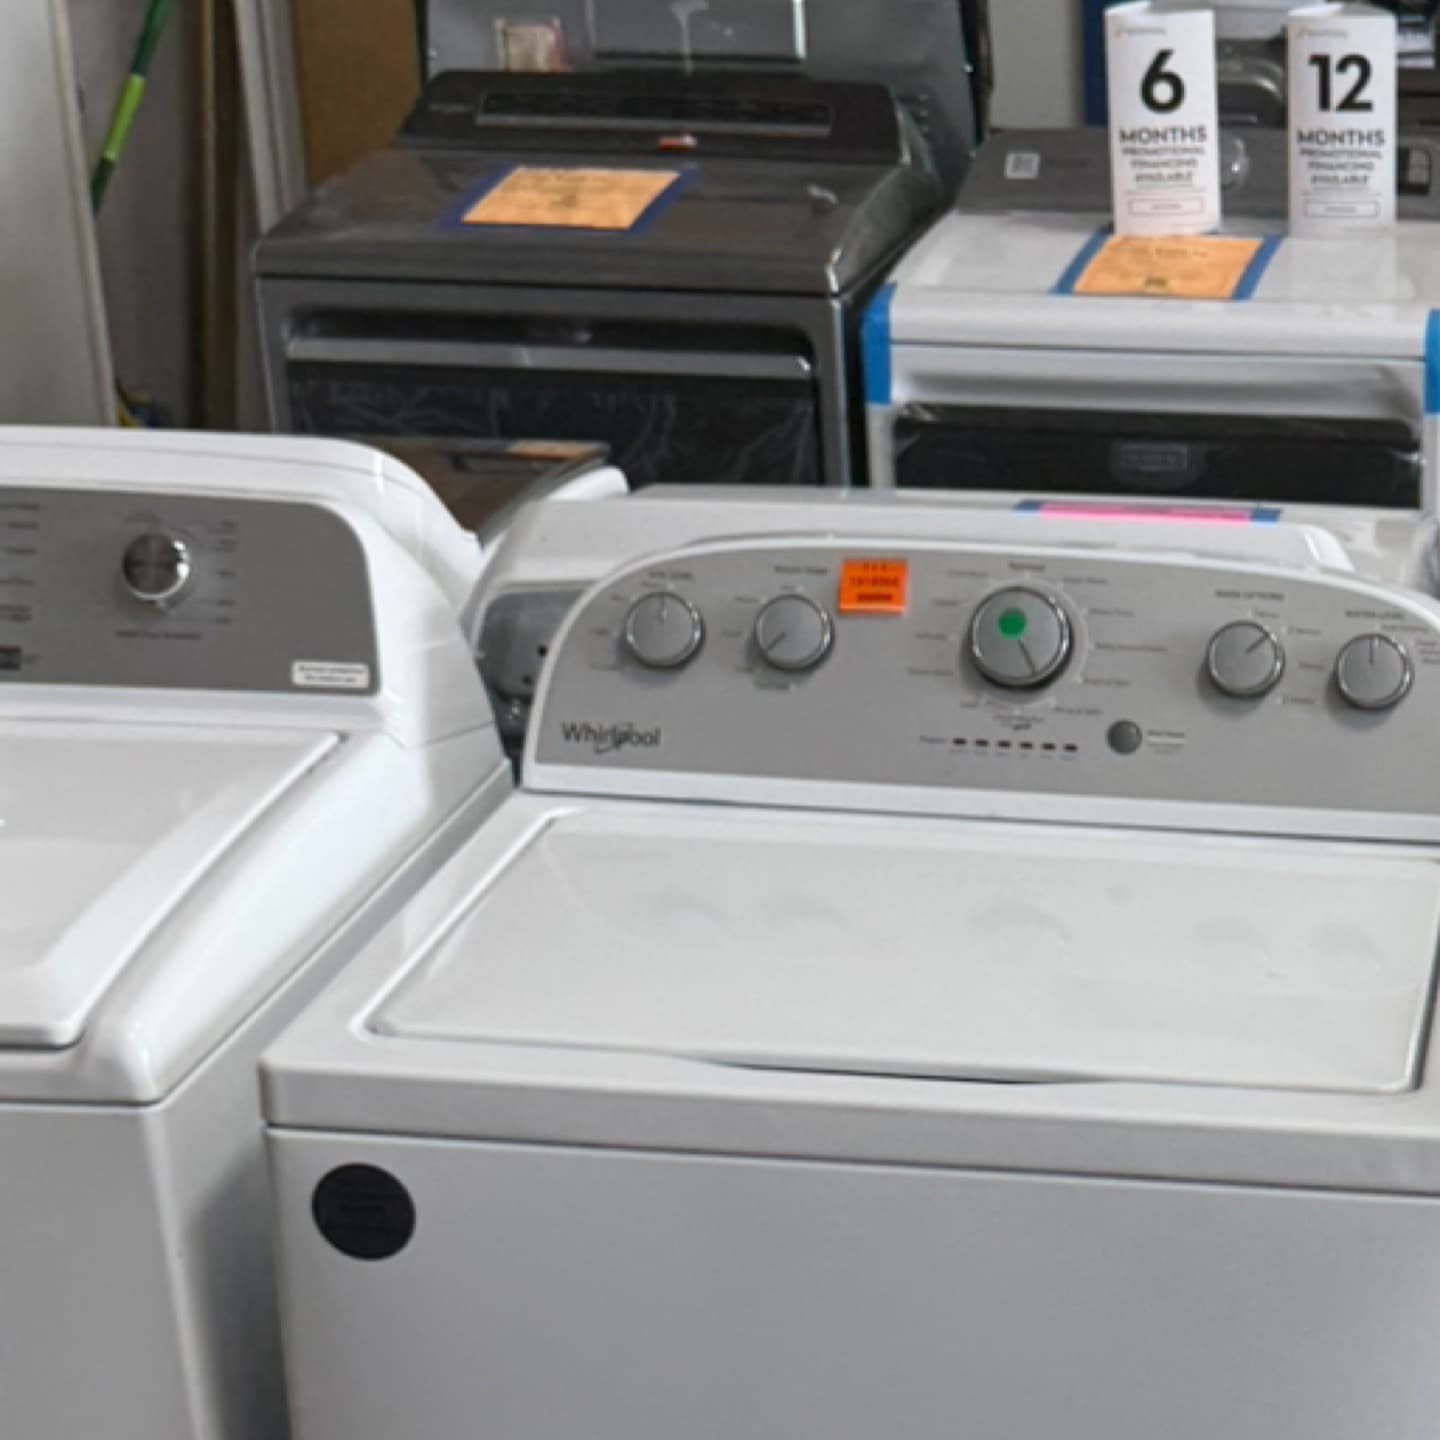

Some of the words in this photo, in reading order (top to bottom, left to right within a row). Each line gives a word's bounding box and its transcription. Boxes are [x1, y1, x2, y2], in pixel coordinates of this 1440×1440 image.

[1140, 48, 1186, 114] 6
[1308, 53, 1374, 112] 12
[1119, 125, 1207, 145] MONTHS
[1297, 129, 1385, 146] MONTHS
[560, 720, 661, 756] Whirlpool
